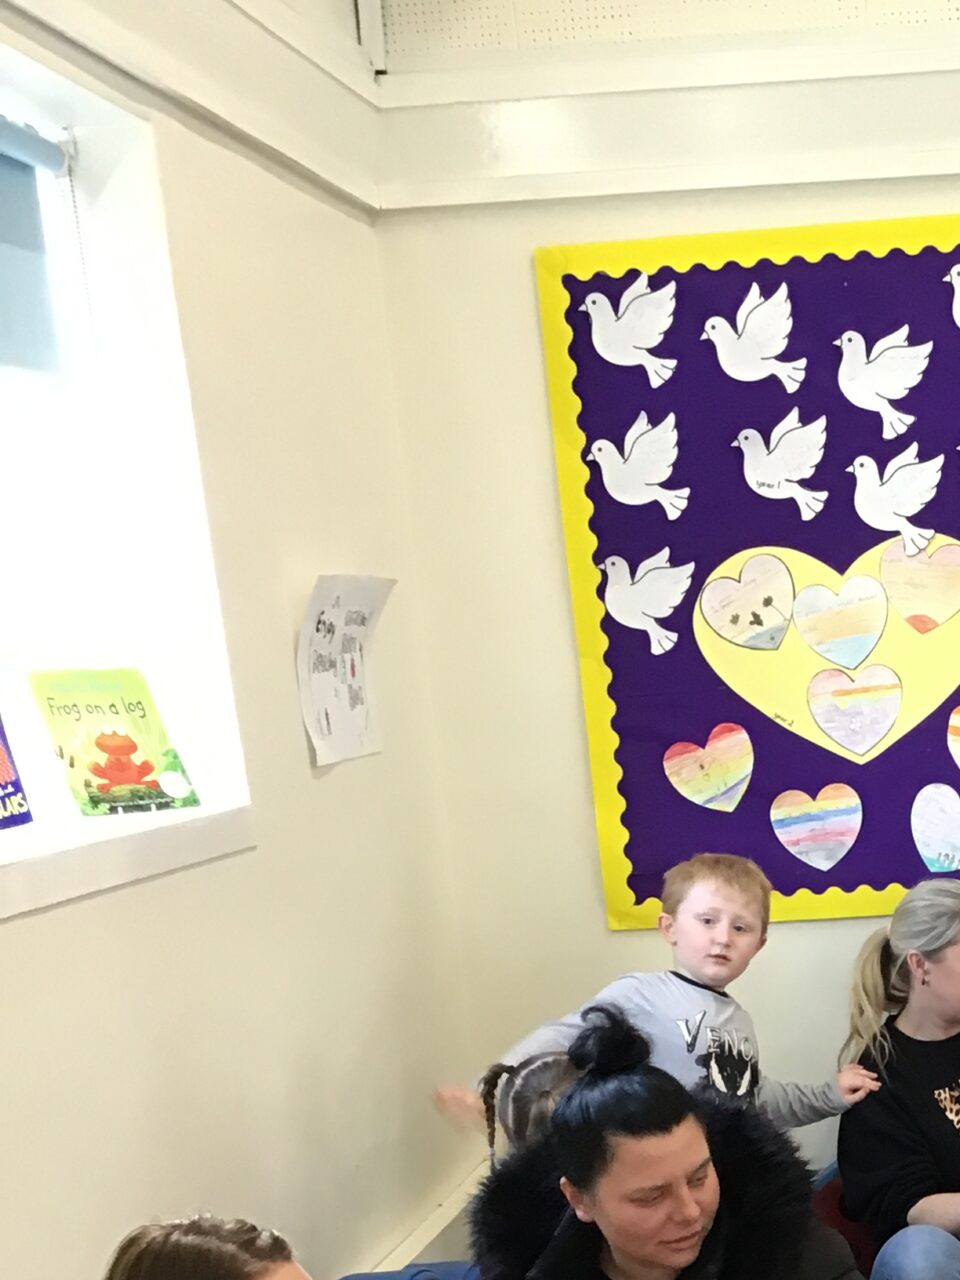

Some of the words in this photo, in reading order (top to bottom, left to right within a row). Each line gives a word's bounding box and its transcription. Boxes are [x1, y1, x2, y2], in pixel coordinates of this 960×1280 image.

[756, 480, 775, 489] year
[46, 697, 82, 722] Frog
[85, 703, 106, 715] on
[108, 703, 120, 715] a
[120, 696, 146, 719] log
[674, 1009, 756, 1063] VENO
